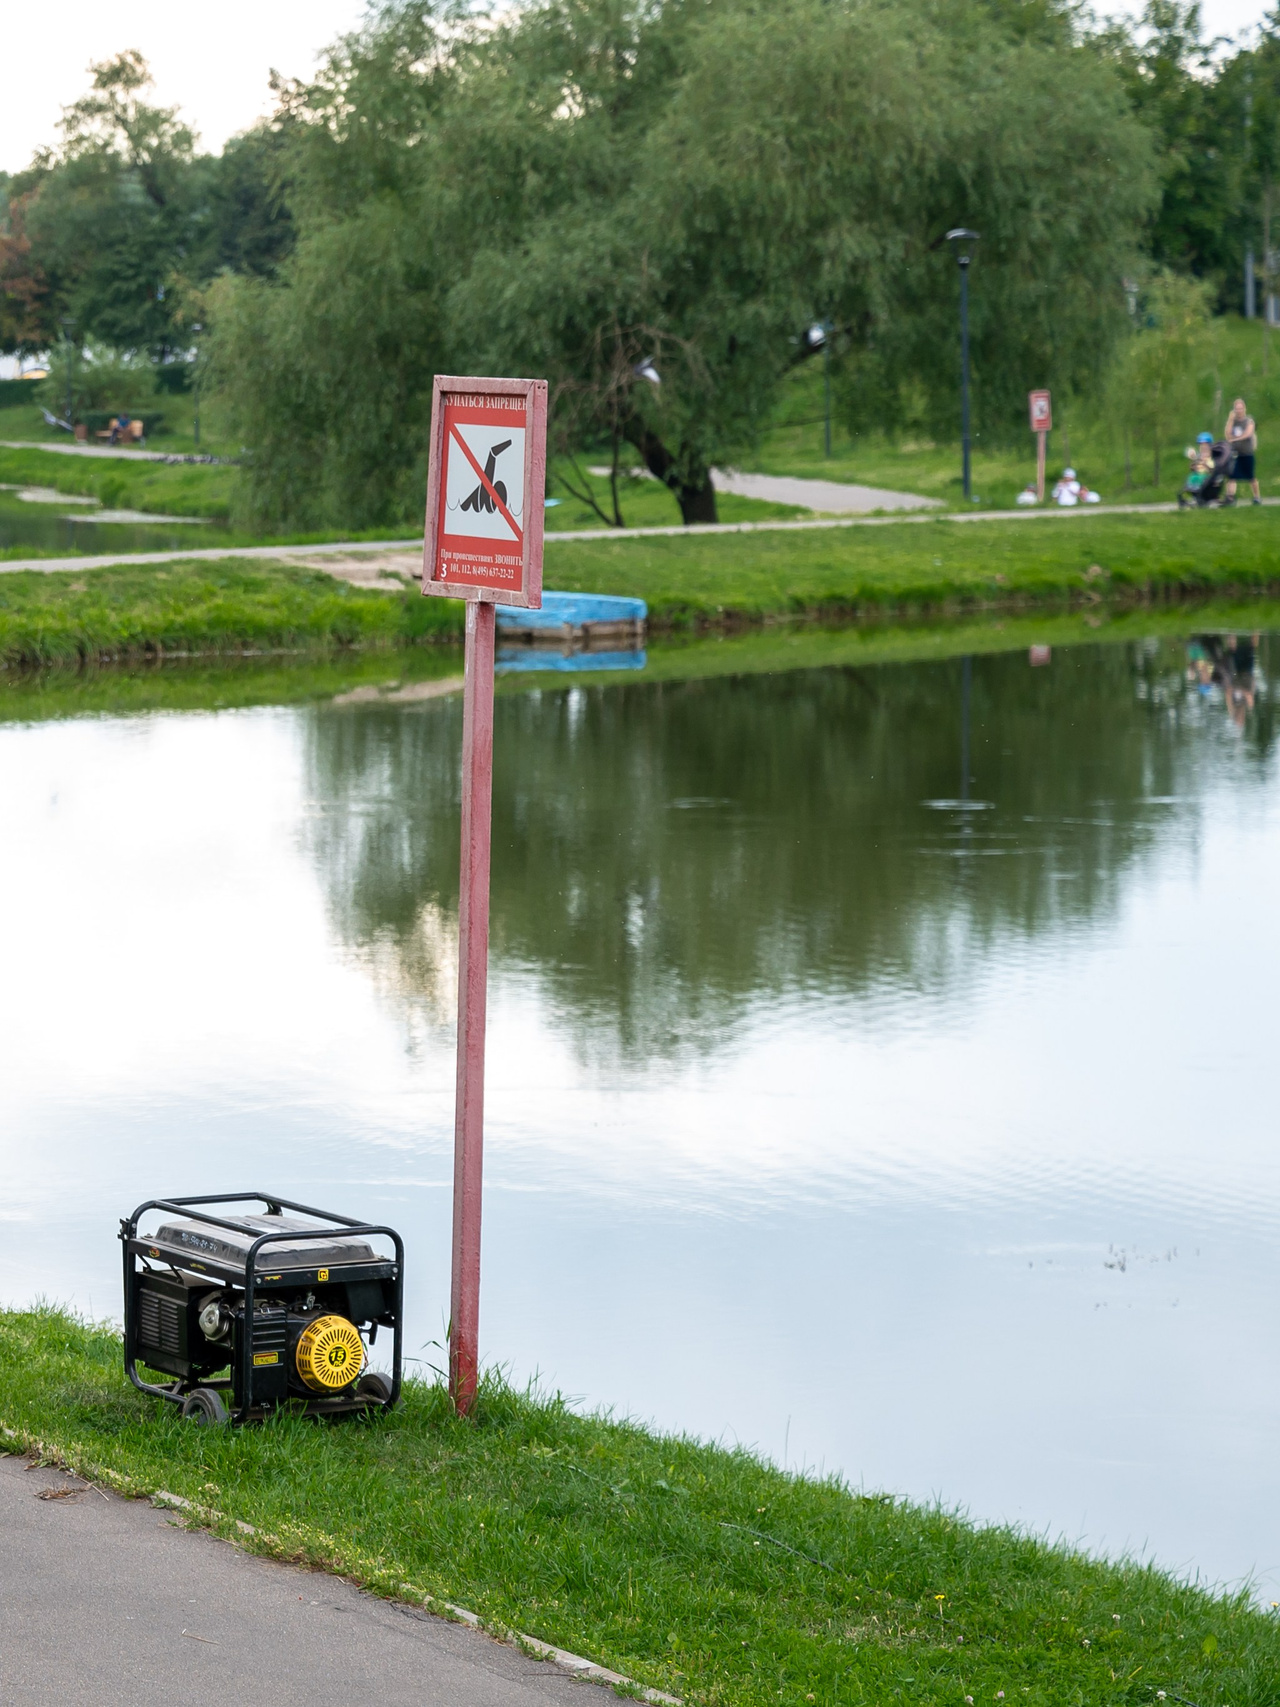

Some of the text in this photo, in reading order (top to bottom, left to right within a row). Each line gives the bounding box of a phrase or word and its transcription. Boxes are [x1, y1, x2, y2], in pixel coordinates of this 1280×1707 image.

[486, 396, 528, 411] ЗАПРЕЩЕН
[441, 548, 452, 560] При
[441, 563, 447, 577] 3
[330, 1351, 344, 1361] 15
